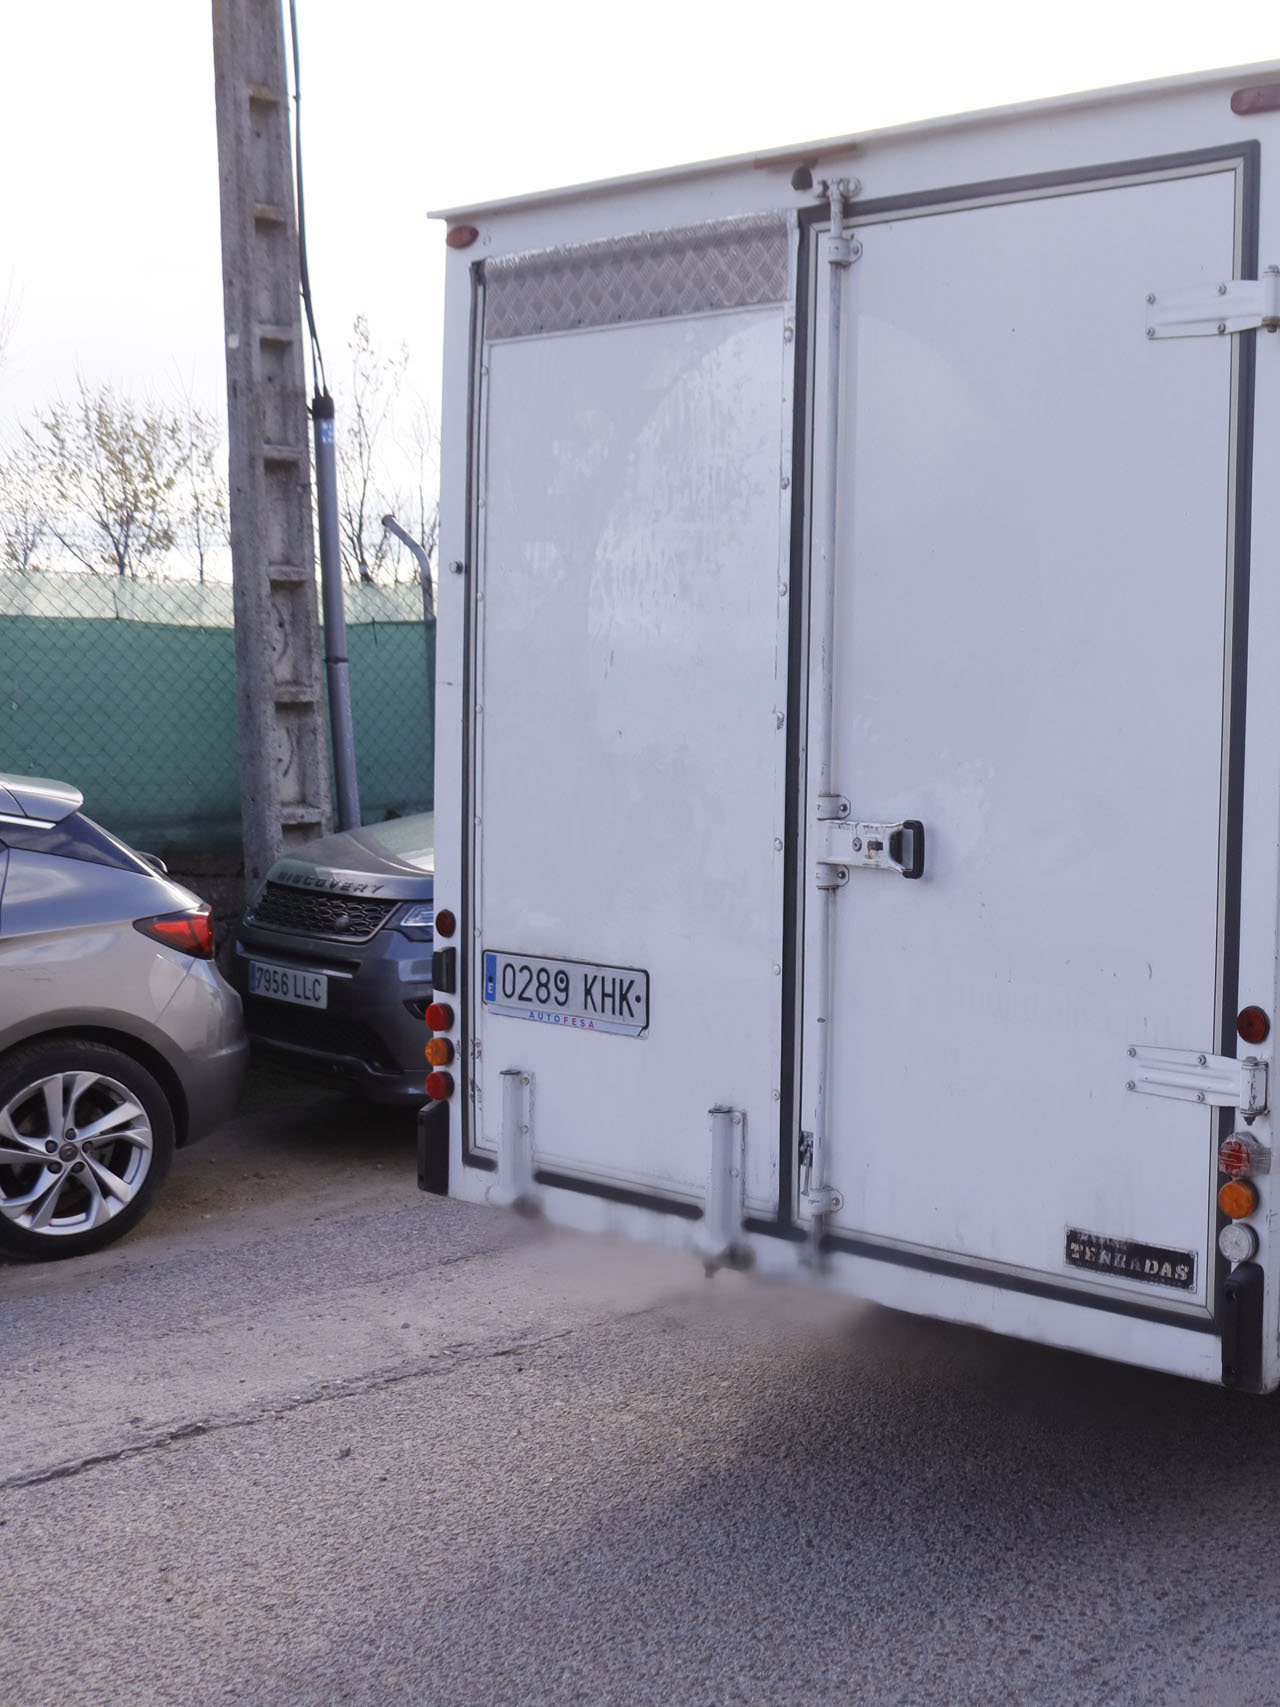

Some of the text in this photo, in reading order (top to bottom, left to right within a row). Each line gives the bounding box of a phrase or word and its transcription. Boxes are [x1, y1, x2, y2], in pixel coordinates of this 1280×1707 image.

[278, 871, 385, 894] DISCOVERY
[256, 967, 321, 1002] 7956 LLC
[502, 963, 636, 1018] 0289 KHK
[529, 1010, 595, 1029] AUTOFESA
